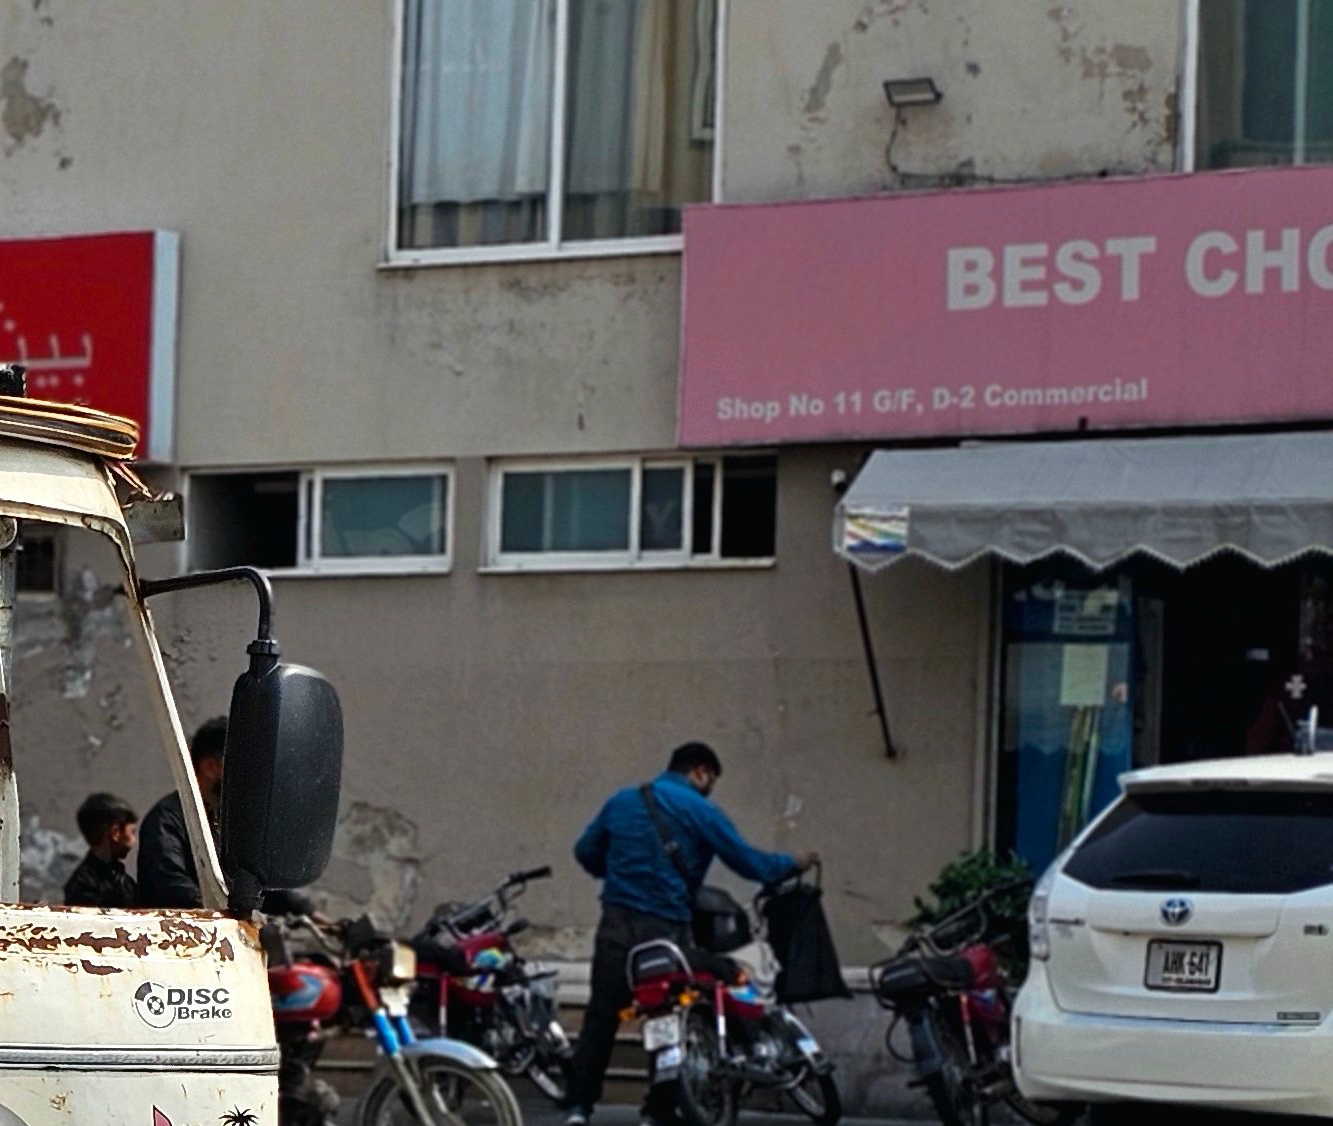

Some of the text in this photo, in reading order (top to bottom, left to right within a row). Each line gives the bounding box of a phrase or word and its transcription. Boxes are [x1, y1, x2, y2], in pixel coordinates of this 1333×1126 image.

[946, 235, 1157, 311] BEST
[717, 396, 780, 423] Shop
[789, 393, 825, 416] No
[834, 390, 862, 414] 11
[933, 384, 976, 410] D-2
[983, 377, 1148, 408] Commercial
[167, 988, 230, 1006] DISC
[177, 1005, 233, 1020] Brake
